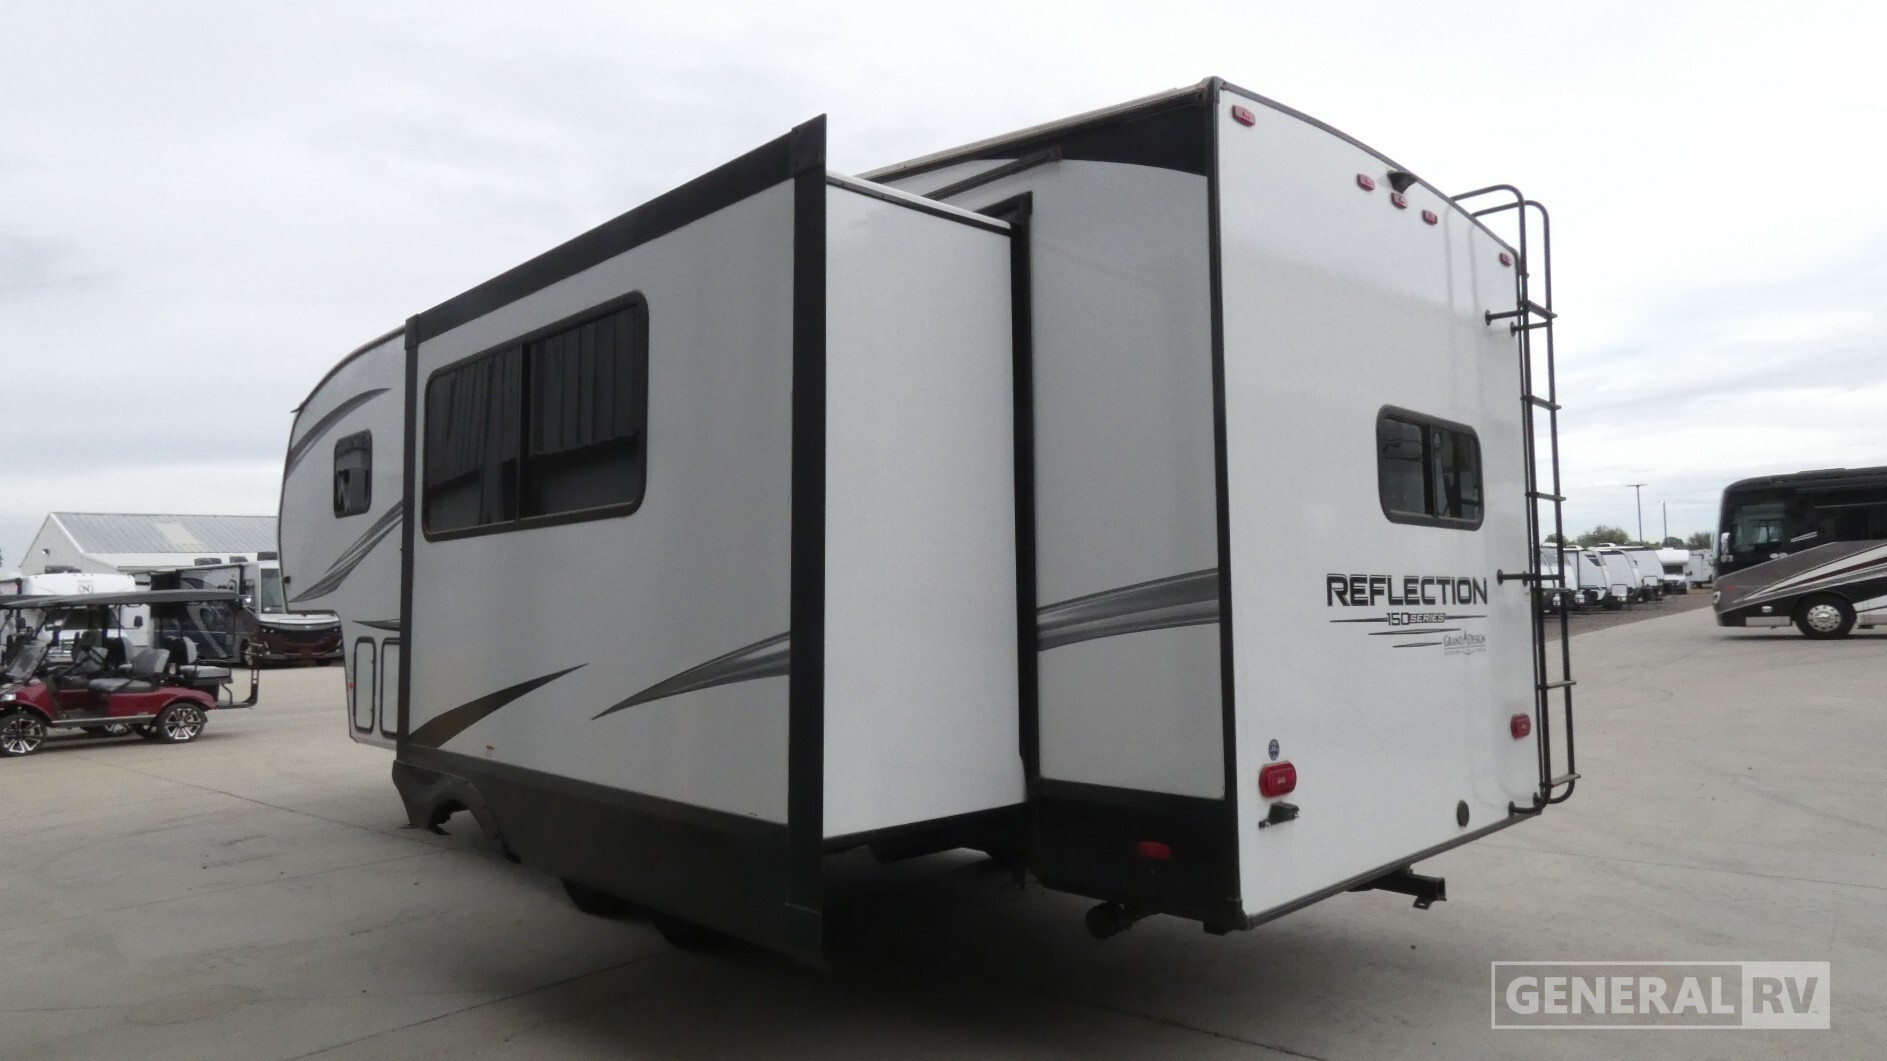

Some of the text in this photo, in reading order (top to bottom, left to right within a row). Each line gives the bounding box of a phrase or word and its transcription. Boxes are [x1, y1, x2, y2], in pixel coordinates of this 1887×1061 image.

[1326, 573, 1488, 607] REFLECTION
[1386, 612, 1444, 626] 150 SERIES
